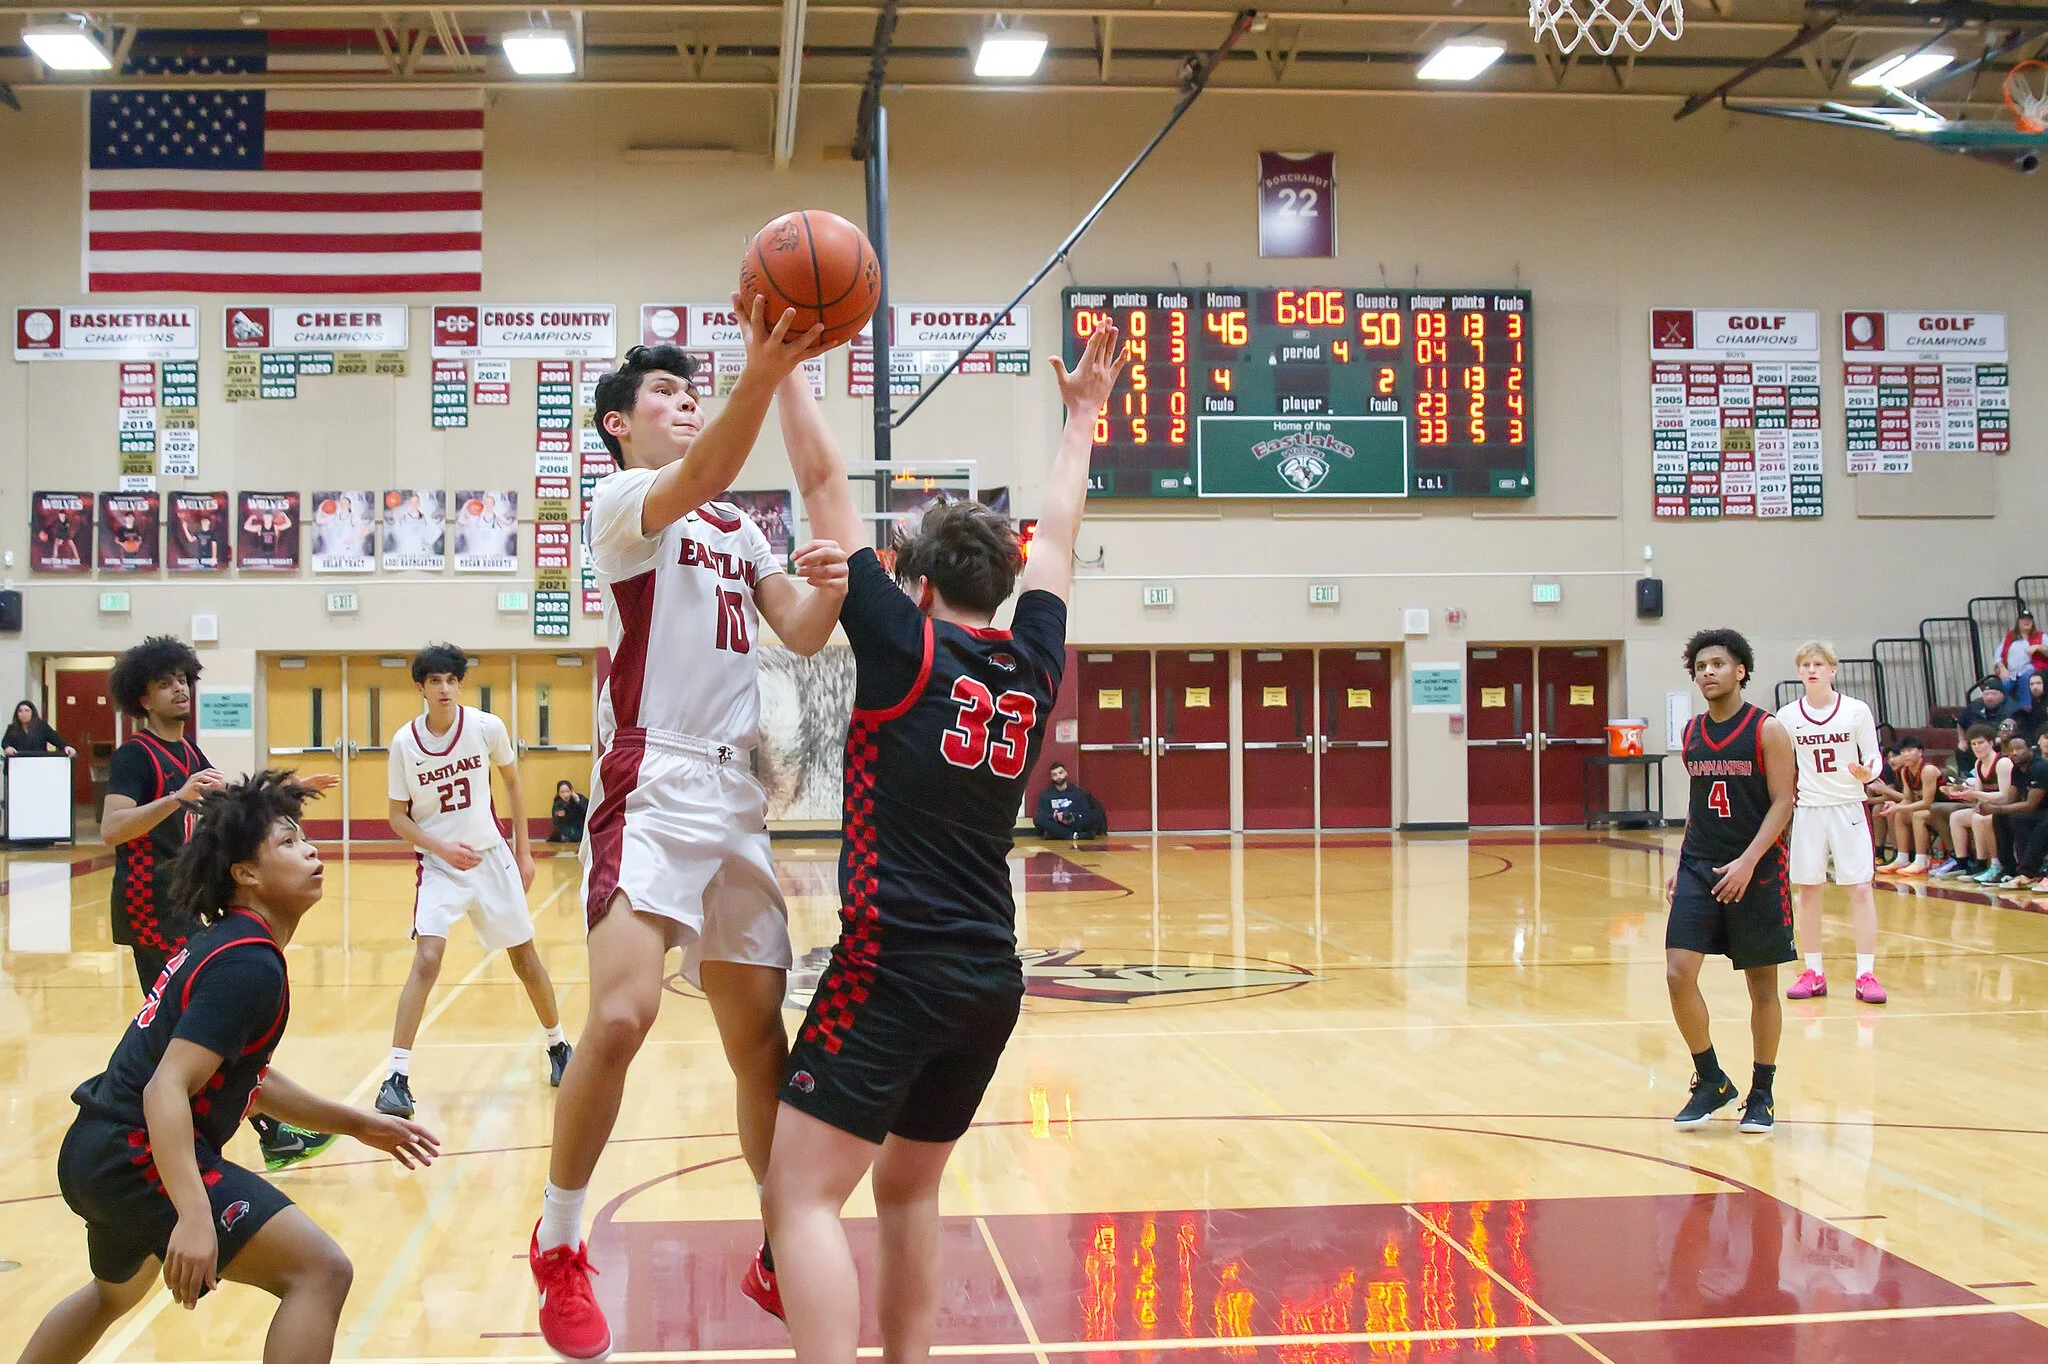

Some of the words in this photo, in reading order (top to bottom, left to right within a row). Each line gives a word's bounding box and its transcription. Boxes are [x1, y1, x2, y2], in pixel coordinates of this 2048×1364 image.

[1278, 188, 1318, 217] 22
[1071, 293, 1106, 308] player
[1113, 293, 1147, 307] points
[1157, 293, 1188, 308] fouls
[1207, 293, 1241, 307] Home
[1357, 294, 1398, 309] Guests
[1410, 295, 1446, 311] player
[1451, 296, 1485, 310] points
[1494, 296, 1524, 311] fouls
[1276, 291, 1345, 325] 6:06
[70, 312, 191, 328] BASKETBALL
[296, 312, 382, 327] CHEER
[484, 312, 534, 327] CROSS
[540, 312, 611, 327] COUNTRY
[910, 312, 1016, 327] FOOTBALL
[1130, 311, 1146, 337] 0
[1171, 311, 1185, 337] 3
[1728, 316, 1786, 330] GOLF
[1919, 317, 1975, 331] GOLF
[1207, 311, 1248, 345] 46
[1360, 312, 1401, 347] 50
[1416, 313, 1447, 338] 03
[1463, 313, 1485, 338] 13
[1507, 313, 1521, 338] 3
[85, 333, 175, 343] CHAMPIONS
[294, 332, 384, 342] CHAMPIONS
[502, 332, 593, 342] CHAMPIONS
[918, 332, 1008, 341] CHAMPIONS
[1716, 335, 1798, 345] CHAMPIONS
[1907, 336, 1987, 346] CHAMPIONS
[1171, 338, 1185, 363] 3
[1283, 345, 1320, 362] period
[1333, 340, 1349, 363] 4
[1416, 339, 1447, 364] 04
[1471, 339, 1484, 362] 7
[1516, 341, 1522, 363] 1
[227, 365, 257, 375] 2012
[890, 364, 918, 373] 2011
[962, 362, 992, 372] 2021
[998, 363, 1028, 373] 2021
[478, 372, 506, 380] 2021
[1131, 365, 1147, 390] 5
[1179, 366, 1186, 389] 1
[1214, 368, 1230, 392] 4
[1379, 368, 1395, 393] 2
[1426, 367, 1447, 389] 11
[1464, 366, 1485, 391] 13
[1508, 367, 1522, 390] 2
[1947, 376, 1973, 384] 2002
[1125, 393, 1147, 415] 11
[1171, 392, 1186, 416] 0
[1205, 397, 1234, 411] fouls
[1282, 395, 1322, 413] player
[1370, 397, 1398, 412] fouls
[1417, 392, 1448, 417] 23
[1470, 392, 1484, 418] 2
[1508, 394, 1523, 416] 4
[1849, 397, 1874, 405] 2013
[123, 421, 153, 429] 2019
[539, 418, 570, 428] 2007
[1273, 421, 1302, 431] Home
[1304, 421, 1314, 431] of
[1316, 421, 1331, 431] the
[1656, 420, 1683, 428] 2008
[1689, 418, 1716, 426] 2008
[1132, 418, 1147, 443] 5
[1170, 418, 1186, 443] 2
[1419, 419, 1448, 444] 33
[1470, 419, 1485, 444] 5
[1509, 419, 1523, 444] 3
[165, 443, 195, 452] 2022
[1251, 430, 1355, 460] Eastlake
[1656, 441, 1685, 450] 2012
[1724, 442, 1750, 450] 2013
[1758, 442, 1785, 450] 2013
[1948, 441, 1975, 449] 2016
[164, 465, 195, 474] 2023
[539, 465, 569, 473] 2008
[1760, 463, 1785, 471] 2016
[1851, 463, 1876, 471] 2017
[1883, 463, 1909, 471] 2017
[1656, 484, 1685, 494] 2017
[1691, 484, 1719, 494] 2017
[1726, 485, 1752, 493] 2017
[1760, 484, 1786, 493] 2017
[42, 499, 84, 510] WOLVES
[108, 500, 149, 511] WOLVES
[177, 499, 218, 510] WOLVES
[247, 499, 290, 510] WOLVES
[1726, 505, 1754, 515] 2022
[538, 512, 568, 520] 2009
[1761, 507, 1788, 515] 2022
[1794, 506, 1822, 515] 2023
[537, 533, 569, 544] 2013
[537, 557, 568, 567] 2021
[538, 581, 567, 590] 2021
[1150, 588, 1169, 604] EXIT
[1315, 586, 1334, 601] EXIT
[333, 594, 352, 609] EXIT
[536, 602, 568, 612] 2023
[716, 584, 750, 655] 10
[536, 625, 568, 635] 2024
[940, 673, 1038, 779] 33
[1796, 732, 1851, 746] EASTLAKE
[1813, 748, 1837, 774] 12
[417, 755, 482, 786] EASTLAKE
[1688, 760, 1752, 777] SAMMAMISH
[437, 777, 472, 814] 23
[1708, 780, 1731, 818] 4
